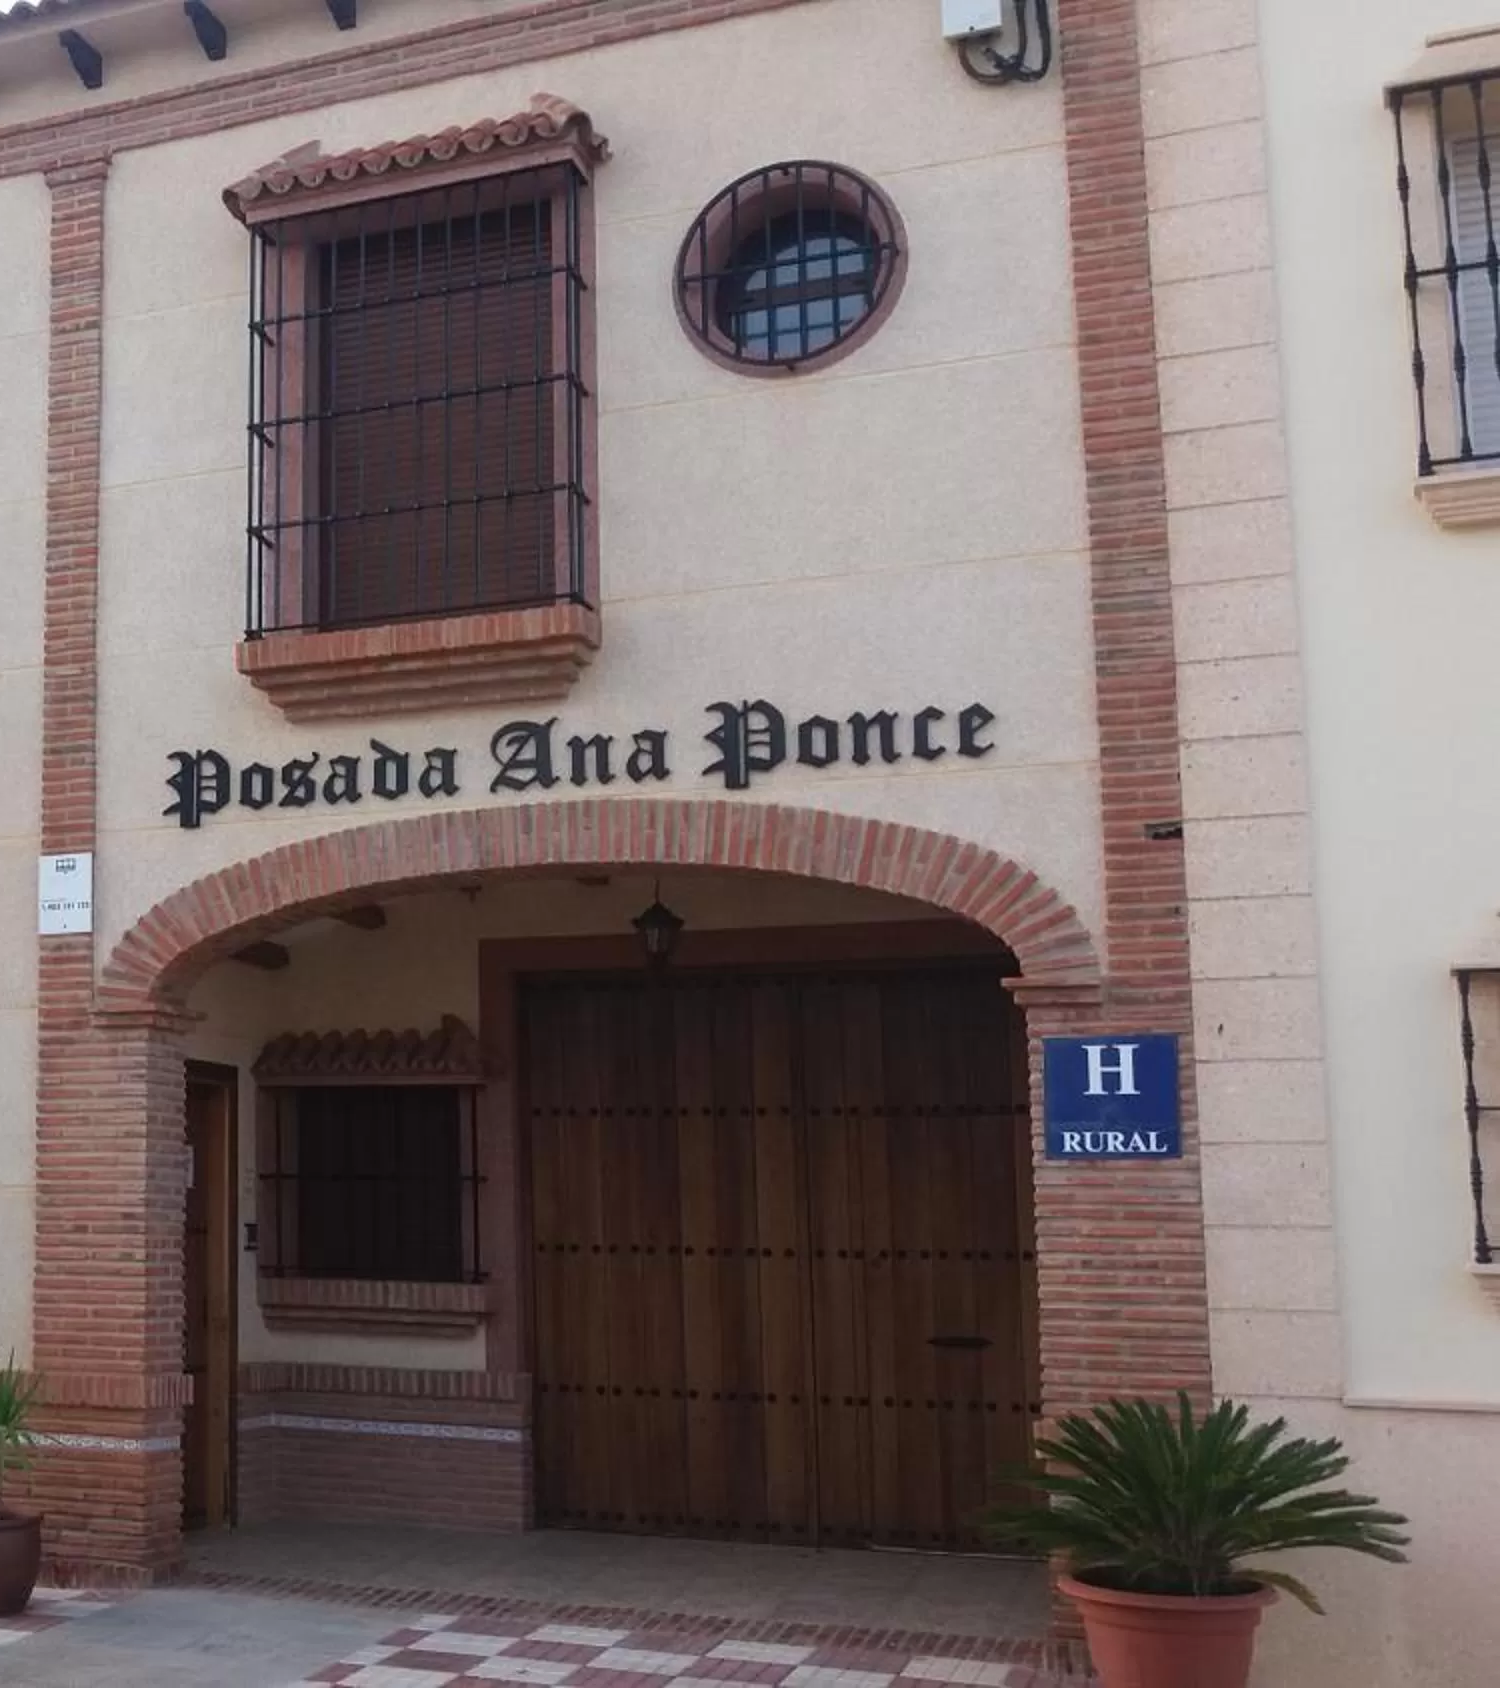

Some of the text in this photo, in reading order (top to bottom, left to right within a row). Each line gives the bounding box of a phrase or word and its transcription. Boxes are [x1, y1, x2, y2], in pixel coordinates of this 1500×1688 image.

[163, 699, 996, 830] Posada Ana Ponce
[1081, 1044, 1141, 1095] H
[1061, 1131, 1168, 1153] RURAL
